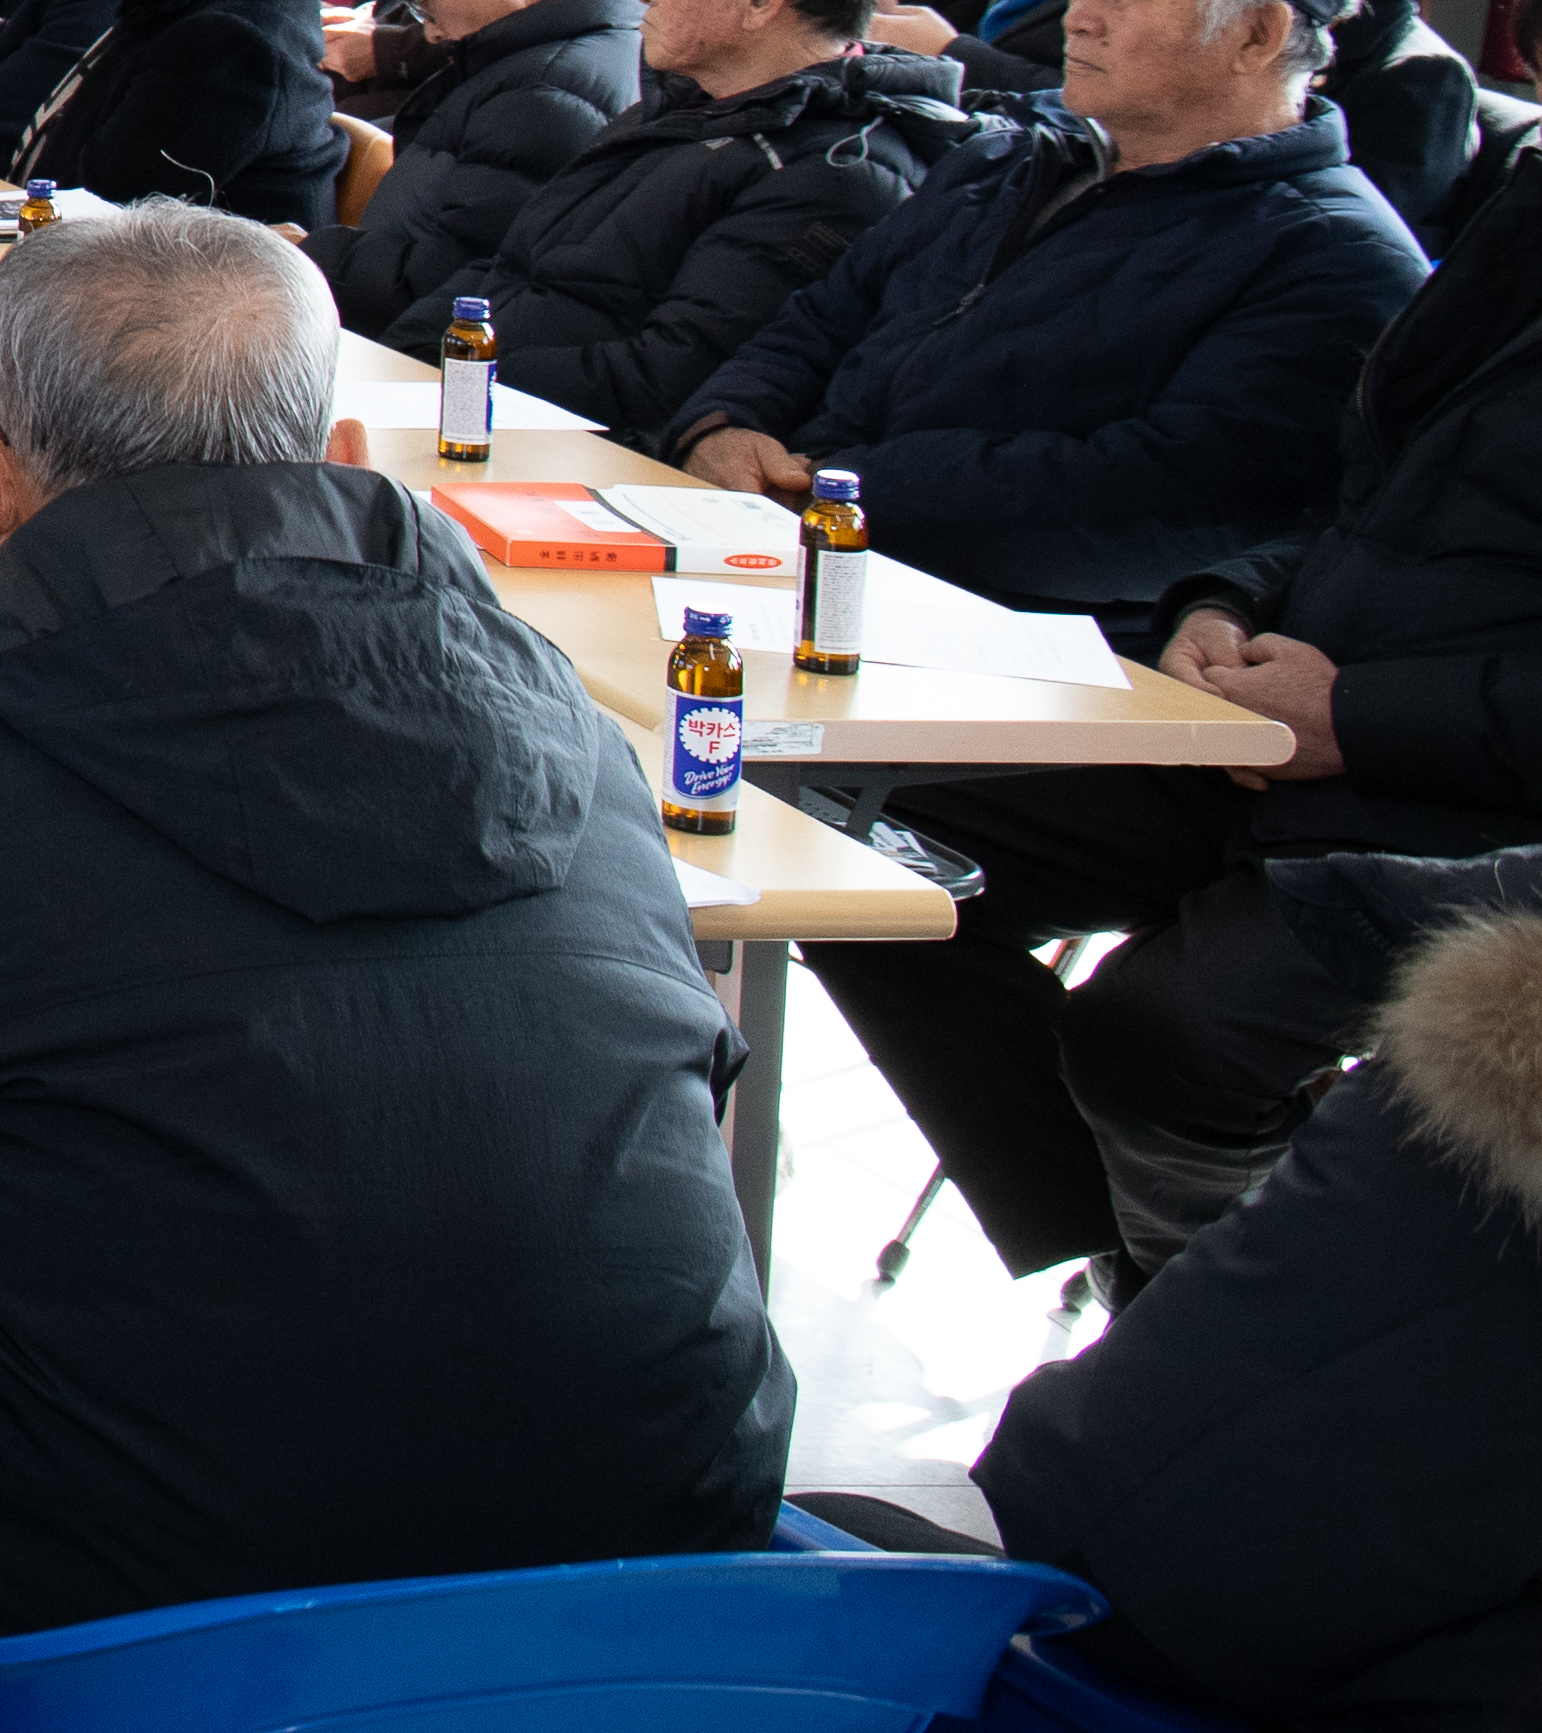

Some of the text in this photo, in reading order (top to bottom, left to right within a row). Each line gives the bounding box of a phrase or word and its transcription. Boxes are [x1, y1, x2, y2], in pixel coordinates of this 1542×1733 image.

[688, 719, 736, 738] 박카스
[709, 741, 721, 755] F
[684, 769, 715, 786] Drive
